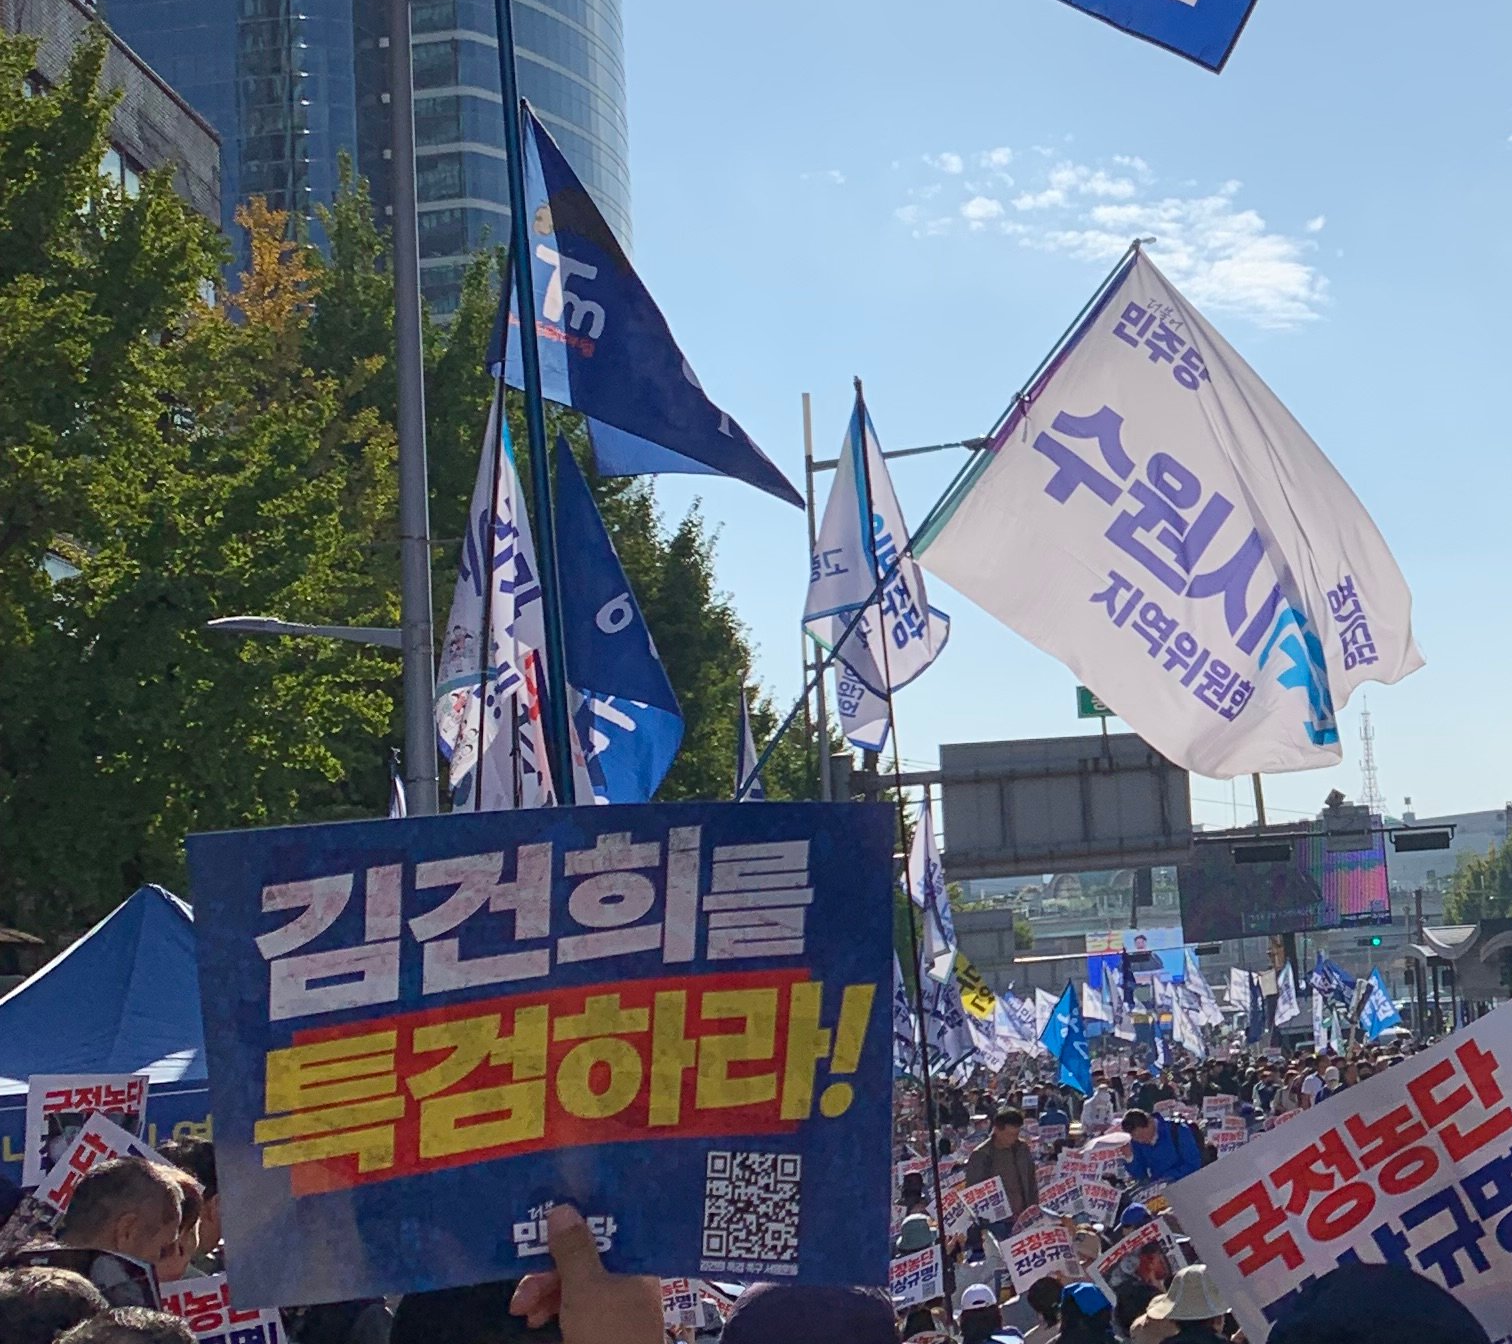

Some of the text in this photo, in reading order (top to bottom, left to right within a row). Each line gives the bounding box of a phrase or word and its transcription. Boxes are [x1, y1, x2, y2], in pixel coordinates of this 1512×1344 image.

[1113, 302, 1211, 390] 민주당
[1328, 575, 1379, 671] 경기도당
[255, 826, 814, 1022] 김건희를
[254, 982, 876, 1173] 특검하라!
[963, 1178, 997, 1204] 정농단
[512, 1216, 618, 1257] 민당
[1010, 1230, 1068, 1257] 국정농단
[890, 1263, 938, 1293] 상규명!
